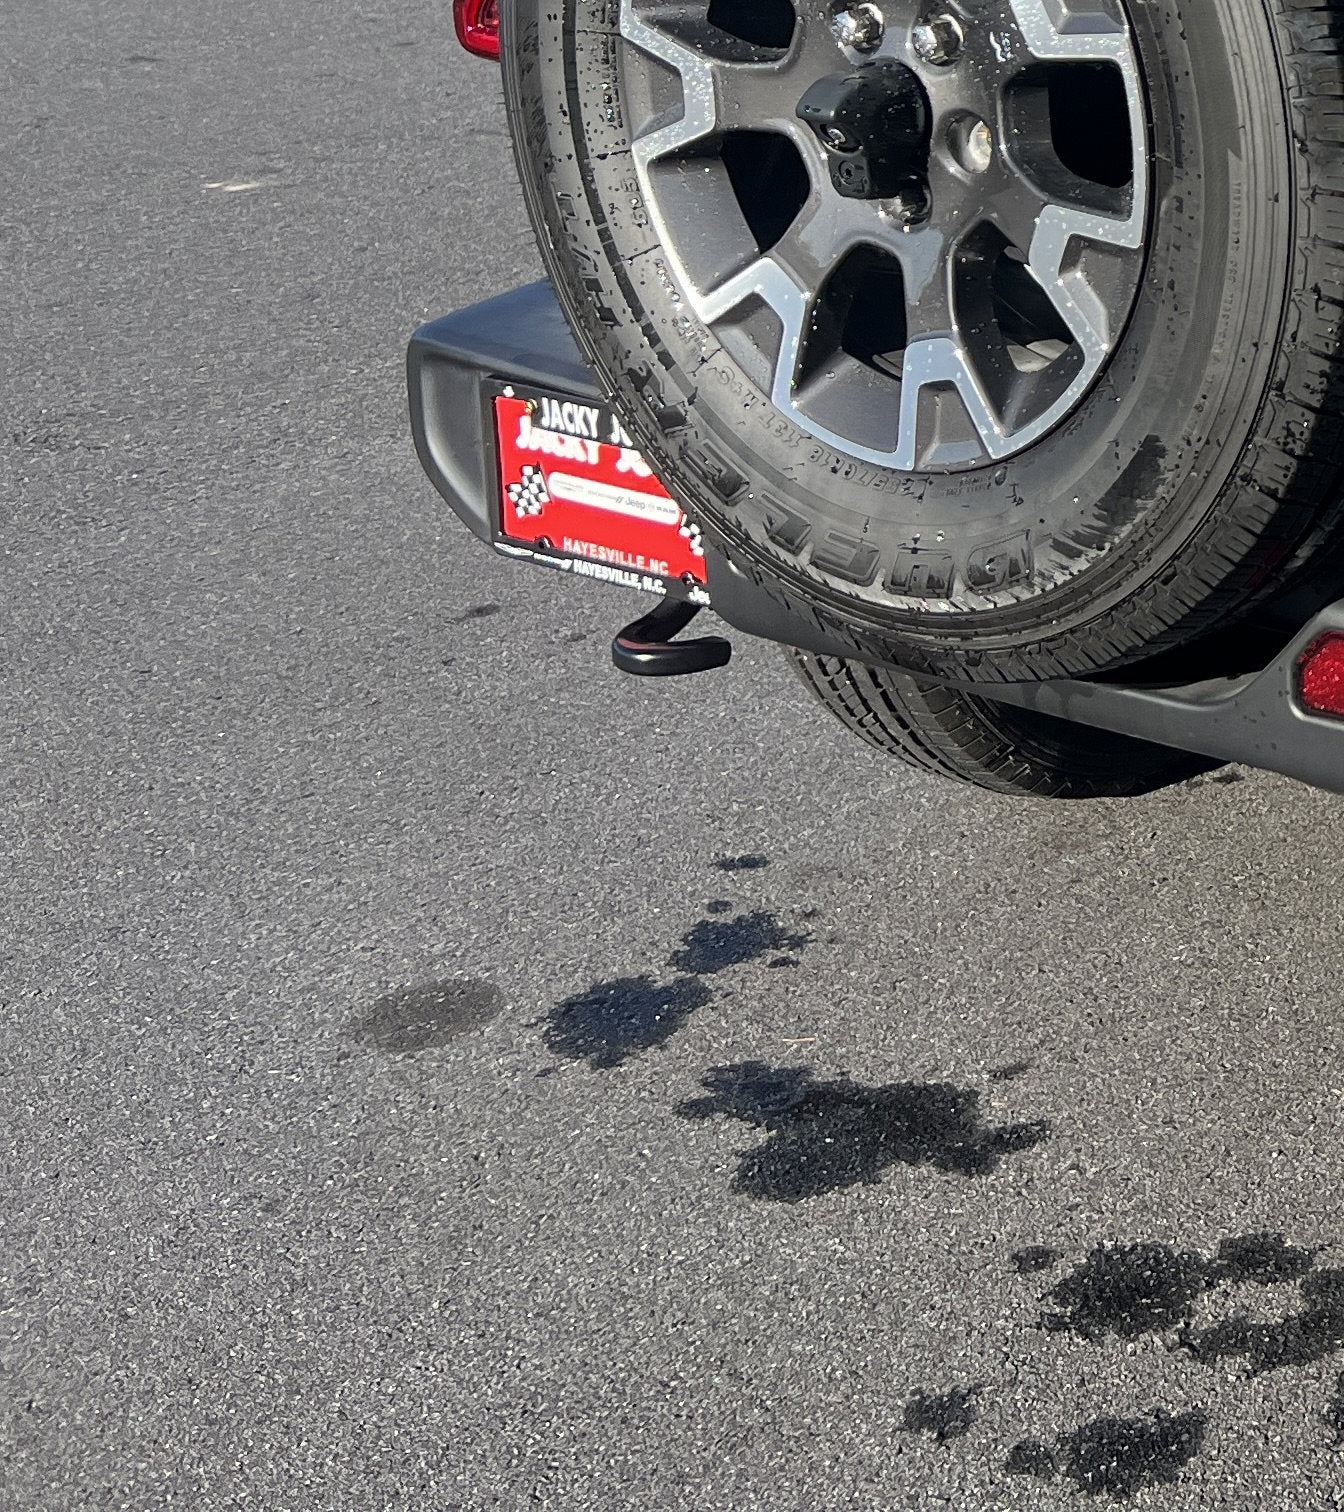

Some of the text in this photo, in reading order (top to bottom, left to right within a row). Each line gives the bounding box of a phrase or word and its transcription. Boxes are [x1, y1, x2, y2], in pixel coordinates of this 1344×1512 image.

[540, 396, 600, 439] JACKY
[515, 415, 602, 465] JACKY
[625, 360, 1035, 599] DUELER
[624, 496, 647, 511] Jeep
[563, 535, 646, 570] HAYESVILLE
[648, 557, 670, 576] NC
[573, 559, 642, 592] HAYESVILLE,
[642, 575, 668, 595] N.C.
